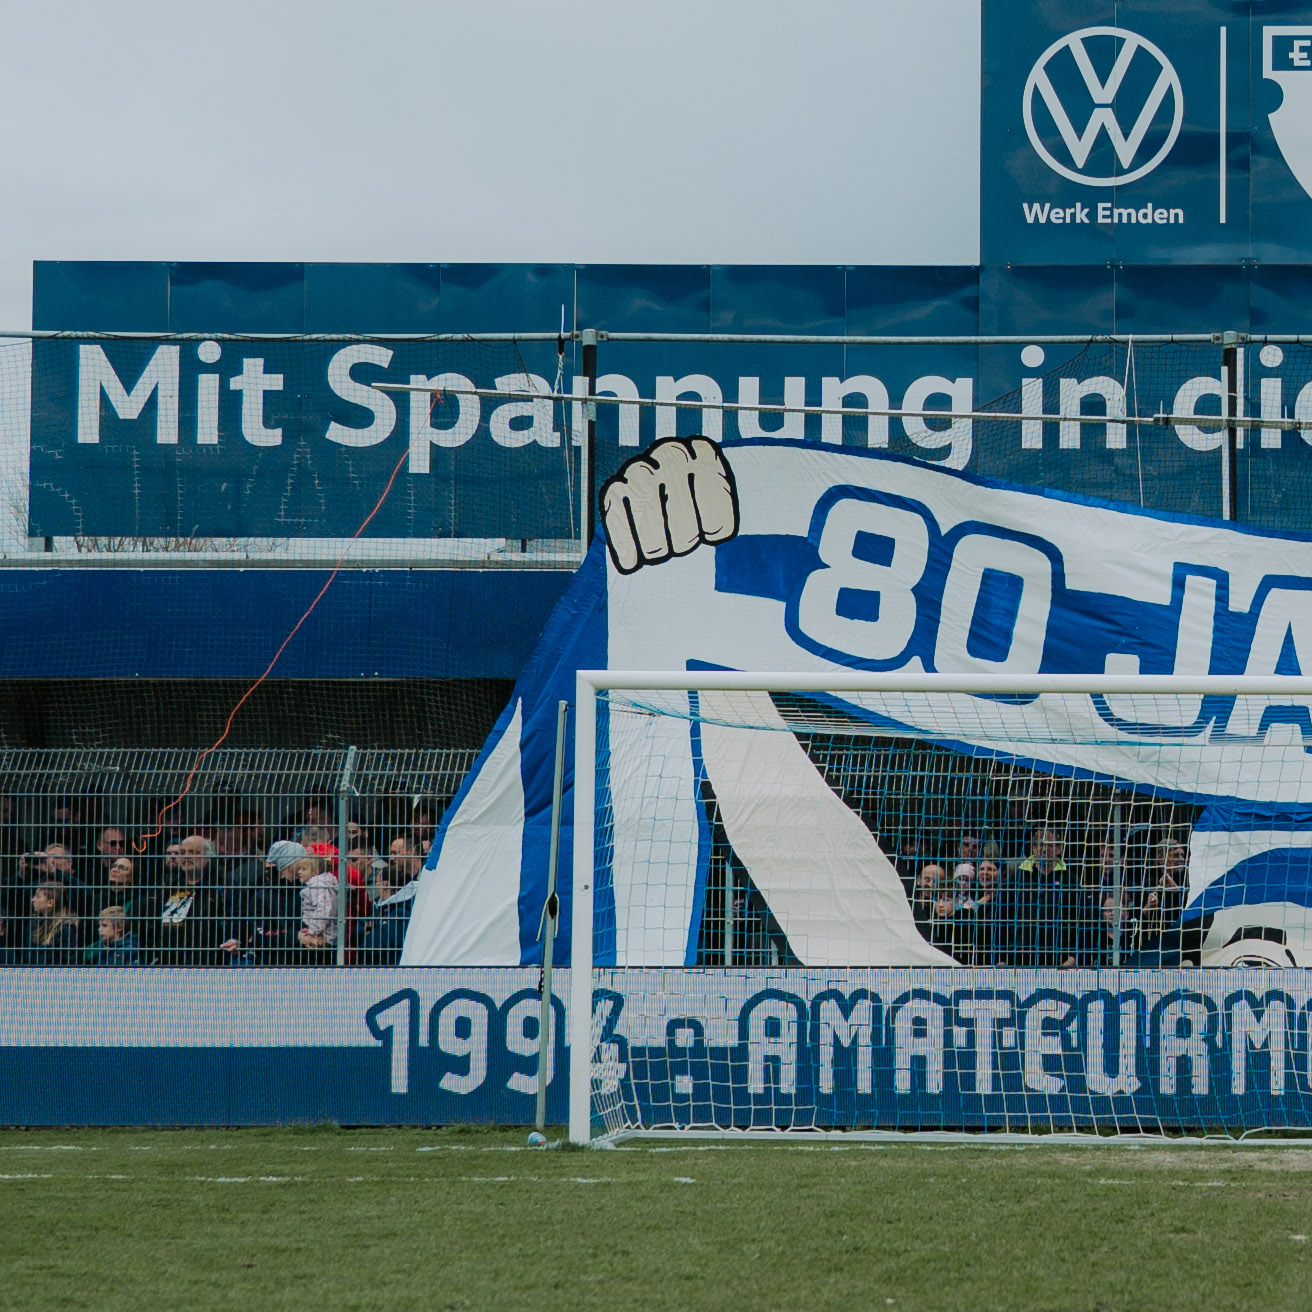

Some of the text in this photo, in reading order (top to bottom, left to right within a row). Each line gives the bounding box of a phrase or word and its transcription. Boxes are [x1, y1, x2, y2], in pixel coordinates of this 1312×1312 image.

[1023, 26, 1184, 186] VW
[1022, 201, 1184, 224] Werk Emden
[77, 340, 284, 448] Mit
[325, 343, 974, 474] Spannung
[1019, 344, 1128, 450] in
[792, 488, 1060, 700] 80
